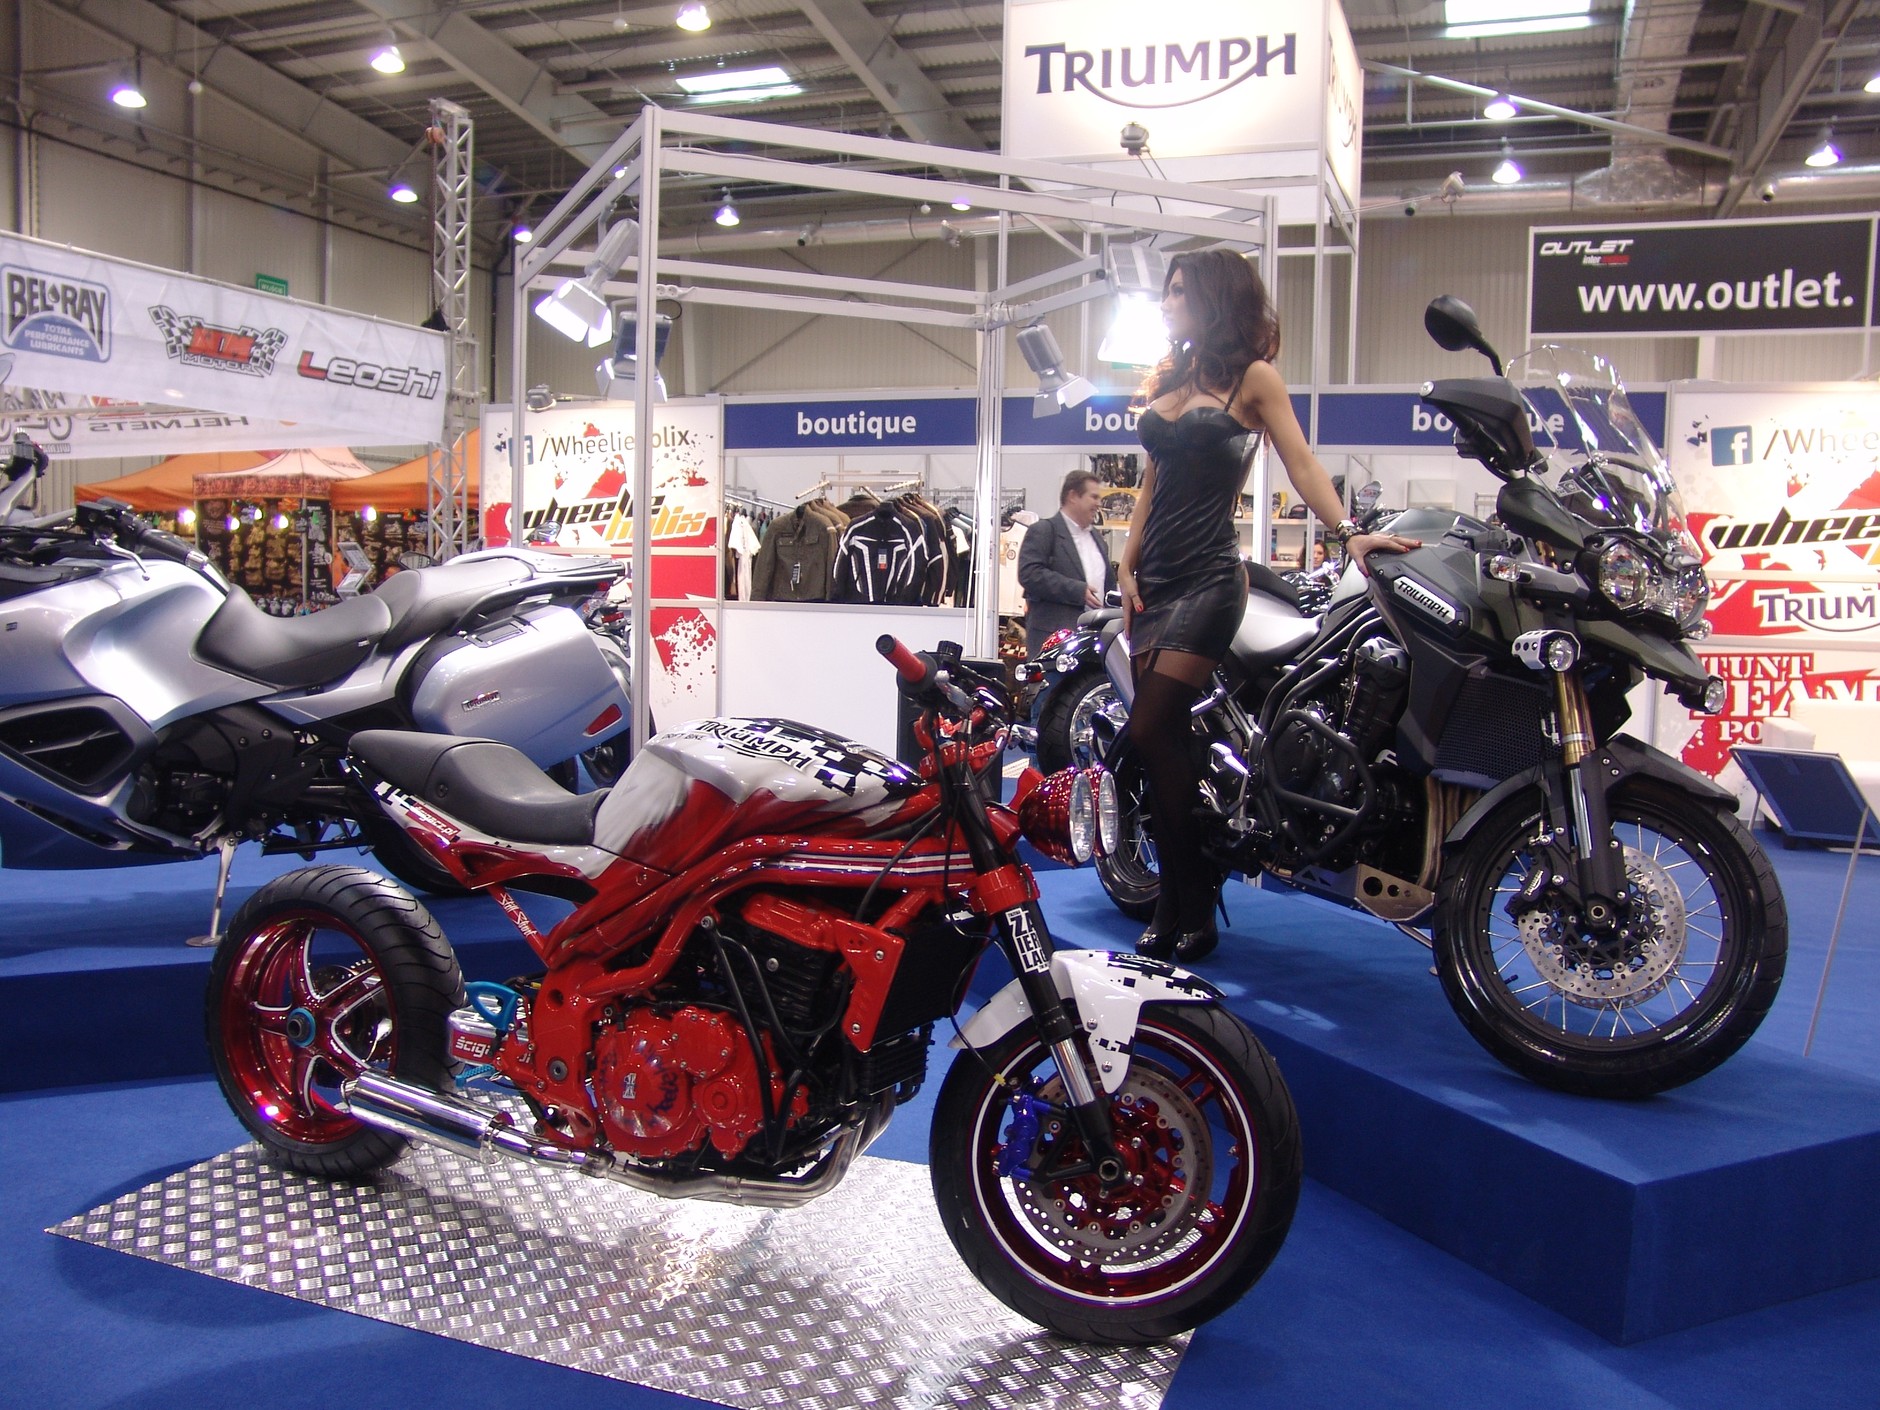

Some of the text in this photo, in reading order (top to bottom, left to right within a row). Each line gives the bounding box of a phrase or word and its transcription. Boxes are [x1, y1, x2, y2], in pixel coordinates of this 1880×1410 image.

[1025, 33, 1297, 109] TRIUMPH
[1540, 239, 1634, 255] OUTLET
[1578, 269, 1854, 312] www.outlet.
[24, 329, 90, 348] PERFORMANCE
[44, 323, 72, 337] TOTAL
[30, 340, 84, 356] LUBRICANTS
[183, 353, 262, 377] MOTOR
[297, 350, 441, 400] Leoshi
[797, 410, 917, 440] boutique
[540, 425, 691, 462] /Wheelieolix
[1398, 581, 1450, 619] TRIUMPH
[1701, 655, 1812, 680] TUNT
[695, 720, 812, 769] TRIUMPH
